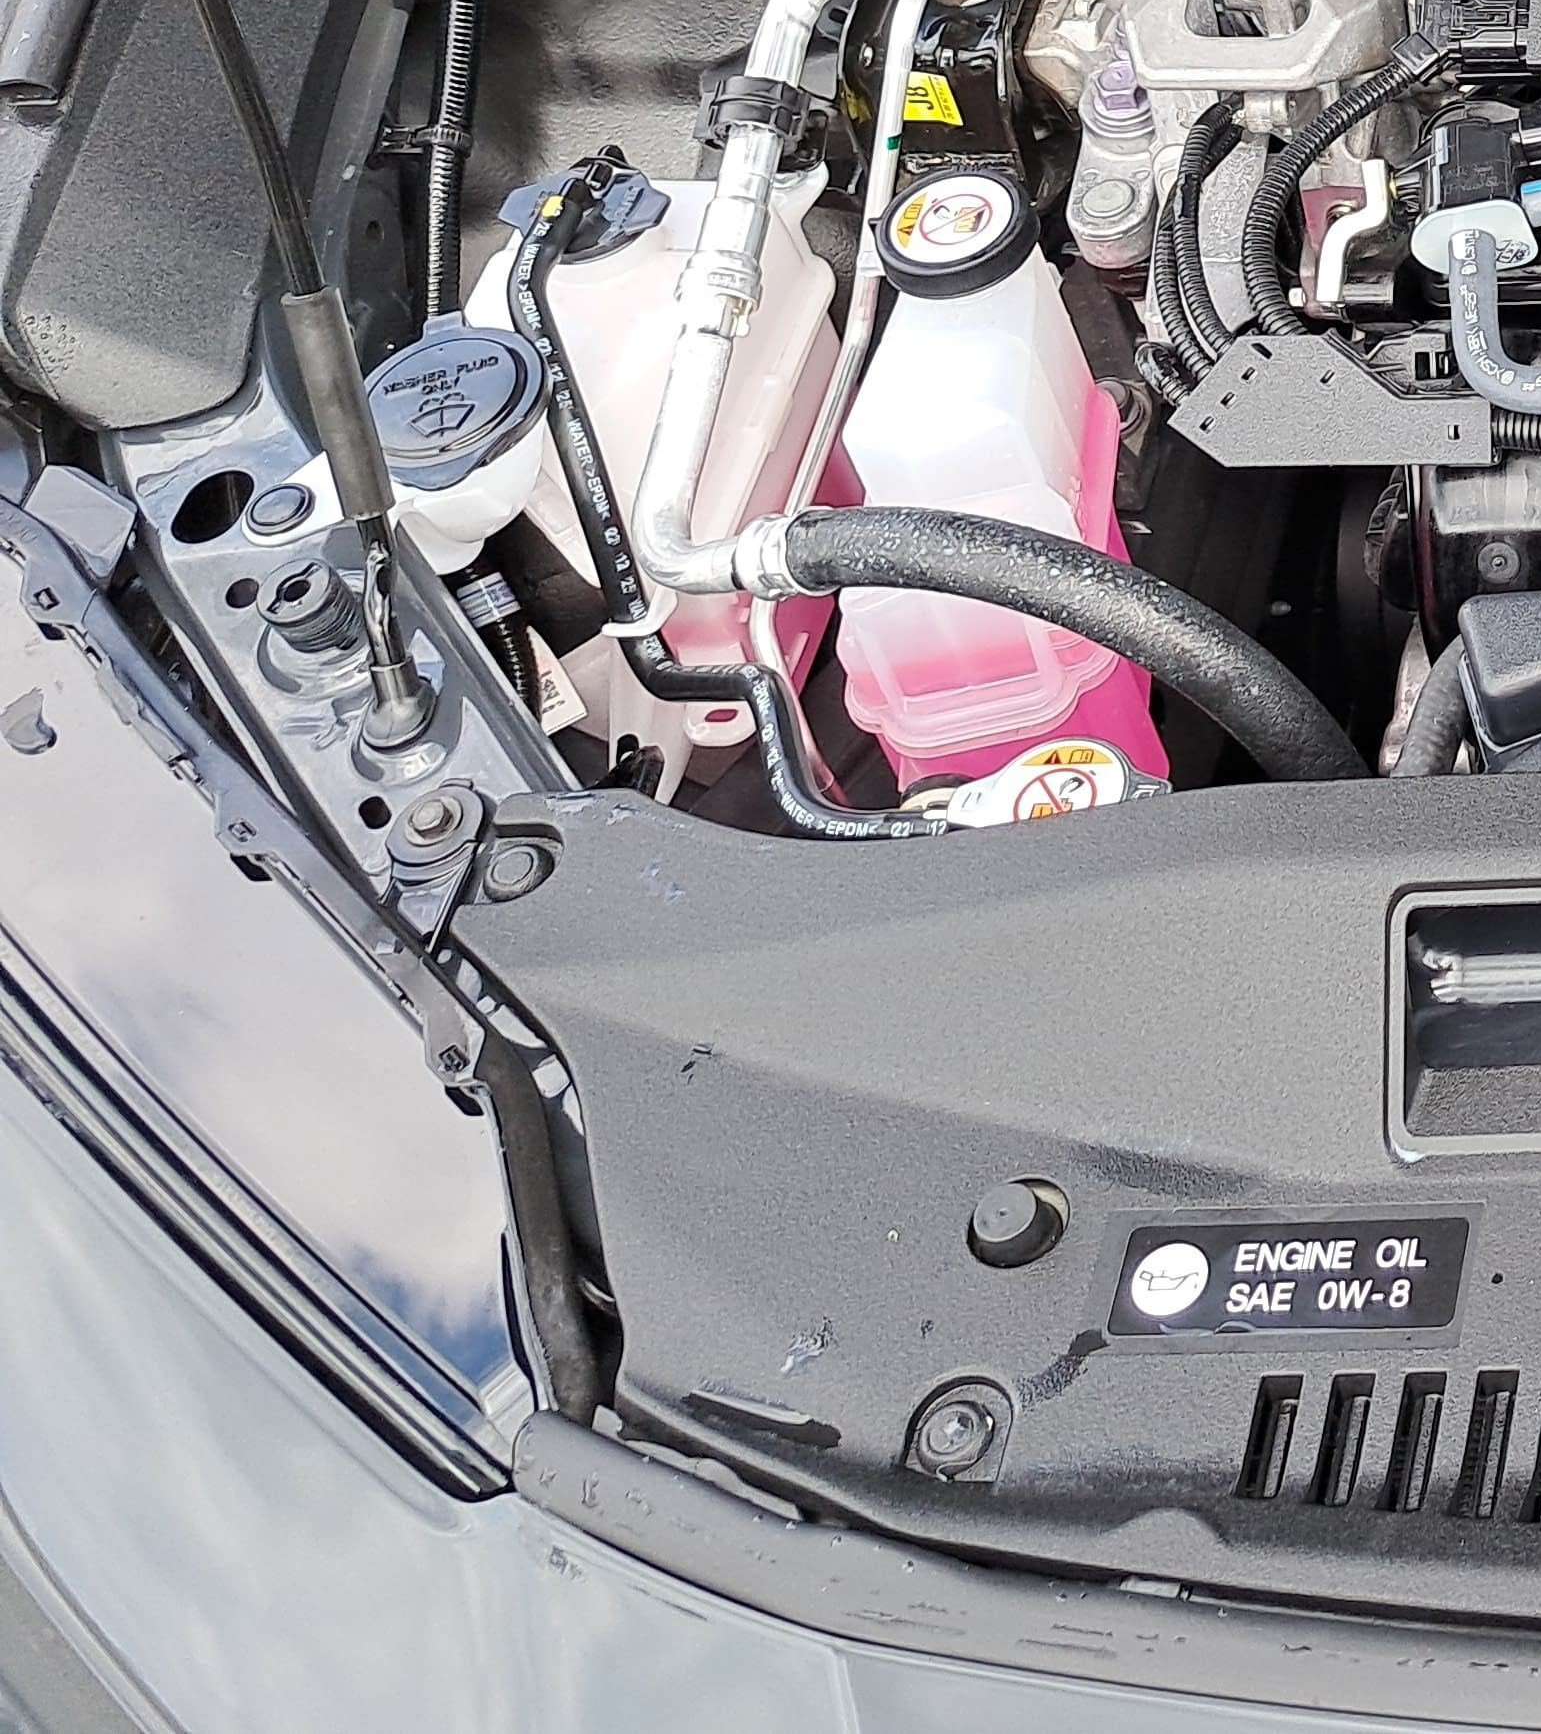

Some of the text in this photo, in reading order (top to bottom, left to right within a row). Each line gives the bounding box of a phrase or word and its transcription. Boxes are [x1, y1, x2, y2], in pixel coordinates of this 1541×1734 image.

[517, 242, 541, 284] WATER
[422, 376, 461, 396] ONLY
[567, 417, 595, 468] WATER
[780, 791, 816, 830] WATER
[1233, 1237, 1428, 1273] ENGINE OIL
[1225, 1278, 1411, 1314] SAE 0W-8
